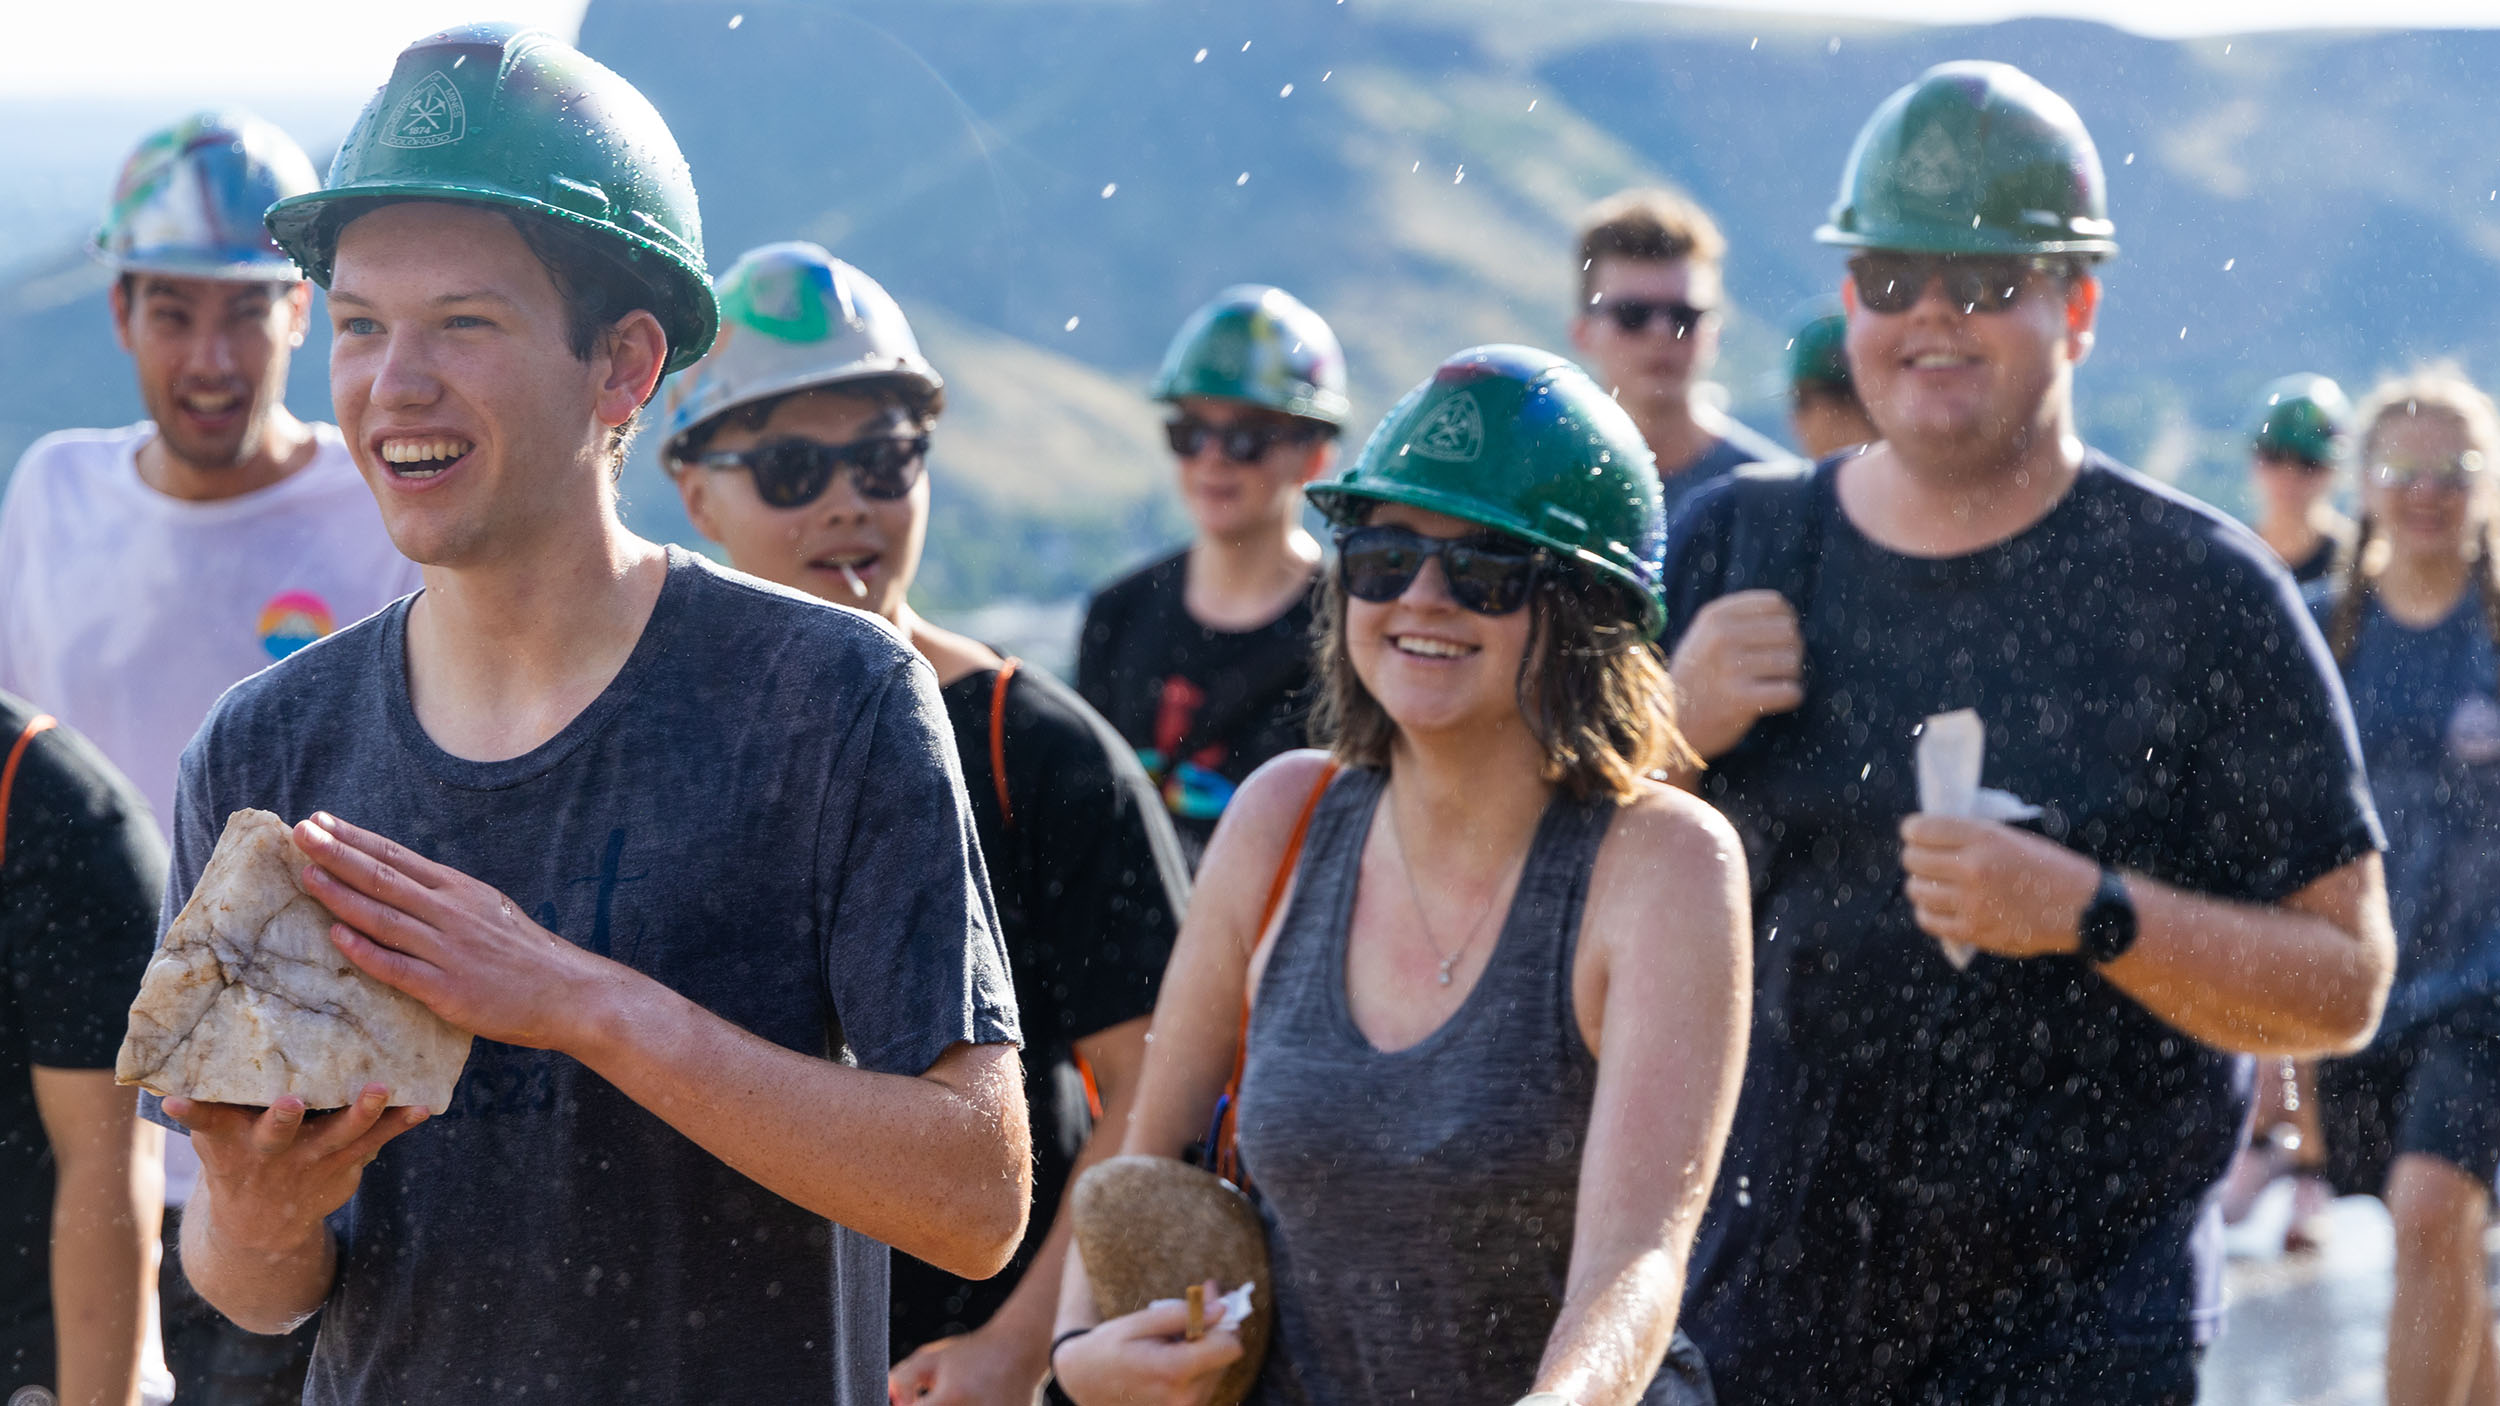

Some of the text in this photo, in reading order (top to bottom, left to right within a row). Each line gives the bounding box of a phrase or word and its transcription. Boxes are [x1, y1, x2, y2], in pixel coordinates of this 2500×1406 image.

[444, 87, 463, 119] MINES
[408, 126, 432, 135] 1874
[388, 134, 451, 146] COLORADO
